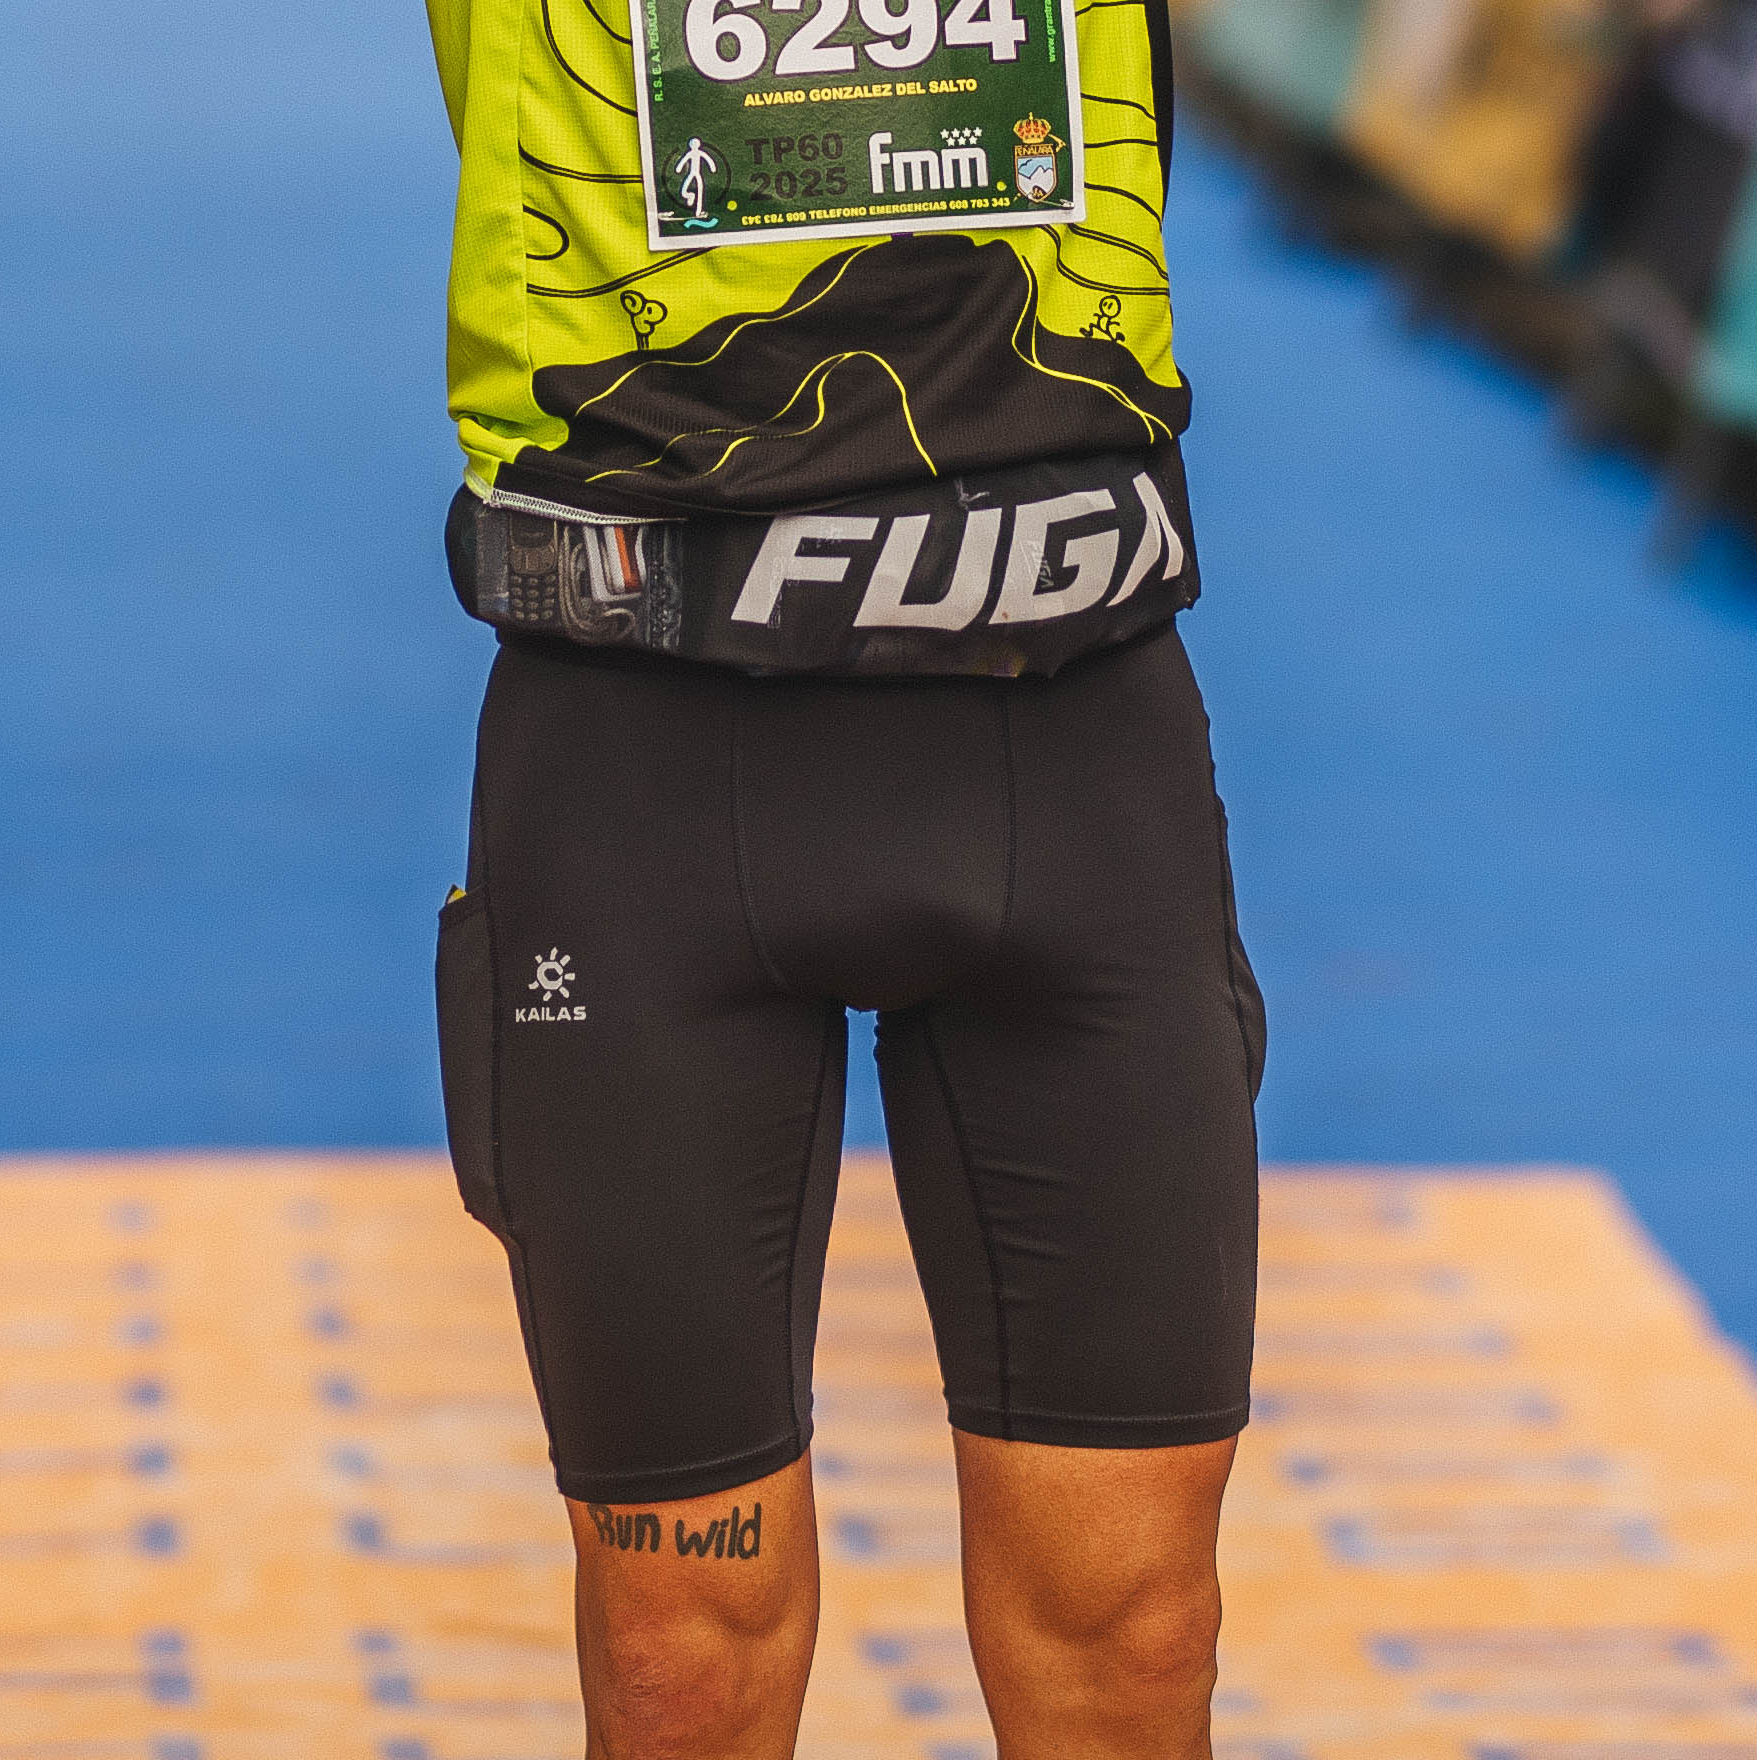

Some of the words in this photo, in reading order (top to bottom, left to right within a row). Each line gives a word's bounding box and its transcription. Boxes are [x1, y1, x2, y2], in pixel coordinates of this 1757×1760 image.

[744, 90, 805, 107] ALVARO
[809, 85, 891, 102] GONZALEZ
[895, 82, 925, 96] DEL
[928, 79, 977, 94] SALTO
[745, 134, 842, 164] TP60
[868, 131, 989, 195] fmm
[749, 166, 848, 200] 2025
[809, 206, 867, 220] TELEFONO
[869, 200, 947, 216] EMERGENCIAS
[515, 1006, 587, 1023] KAILAS
[674, 1502, 763, 1561] wild
